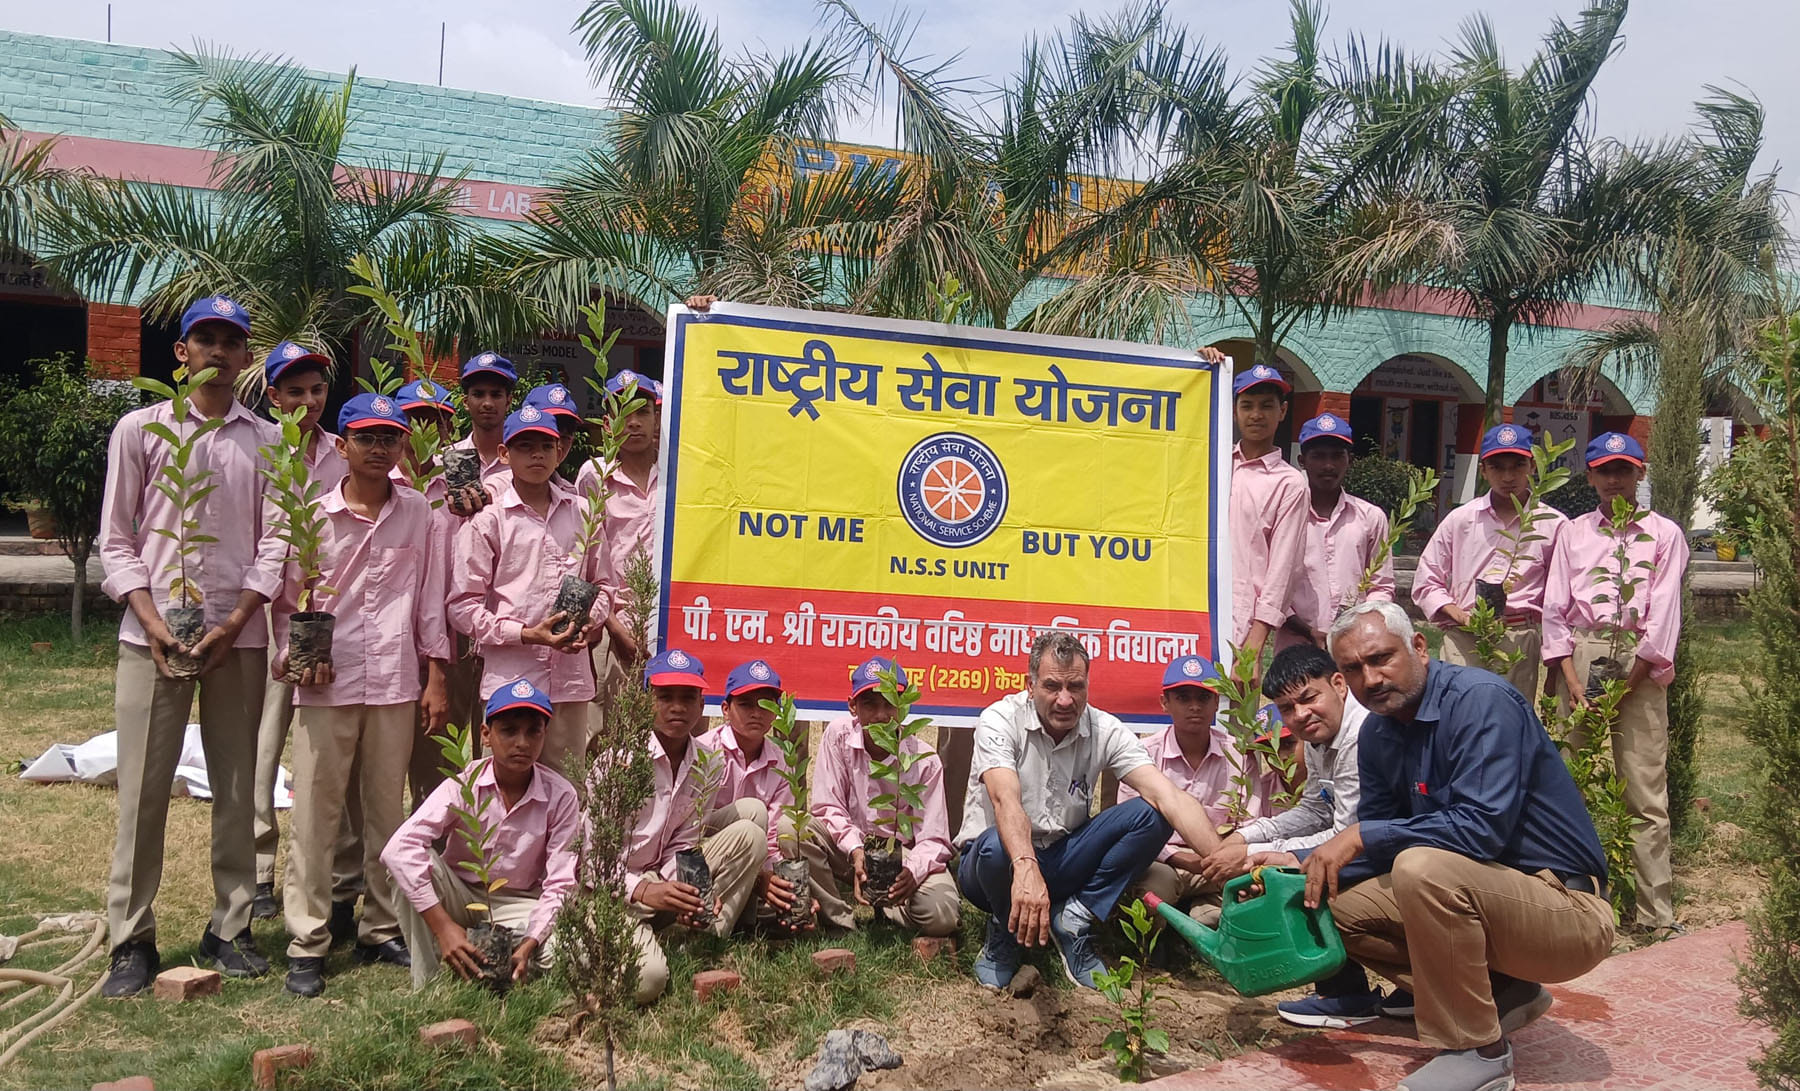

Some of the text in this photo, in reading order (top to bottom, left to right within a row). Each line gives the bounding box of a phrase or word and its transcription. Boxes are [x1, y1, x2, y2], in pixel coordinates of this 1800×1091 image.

[487, 189, 531, 215] LAB
[542, 345, 578, 359] MODEL
[717, 339, 1182, 431] राष्ट्रीय सेवा योजना
[908, 439, 996, 480] राष्ट्रीय सेवा योजना
[739, 511, 864, 542] NOT ME
[908, 493, 998, 537] NATIONAL SERVICE SCHEME
[1022, 531, 1152, 561] BUT YOU
[890, 556, 1009, 580] N.S.S UNIT
[682, 595, 717, 641] पी.
[724, 608, 774, 644] एम.
[782, 601, 817, 646] श्री
[820, 606, 920, 651] राजकीय
[924, 610, 988, 657] वरिष्ठ
[1106, 619, 1199, 664] विद्यालय
[930, 664, 990, 694] (2269)
[994, 666, 1027, 691] कैथ
